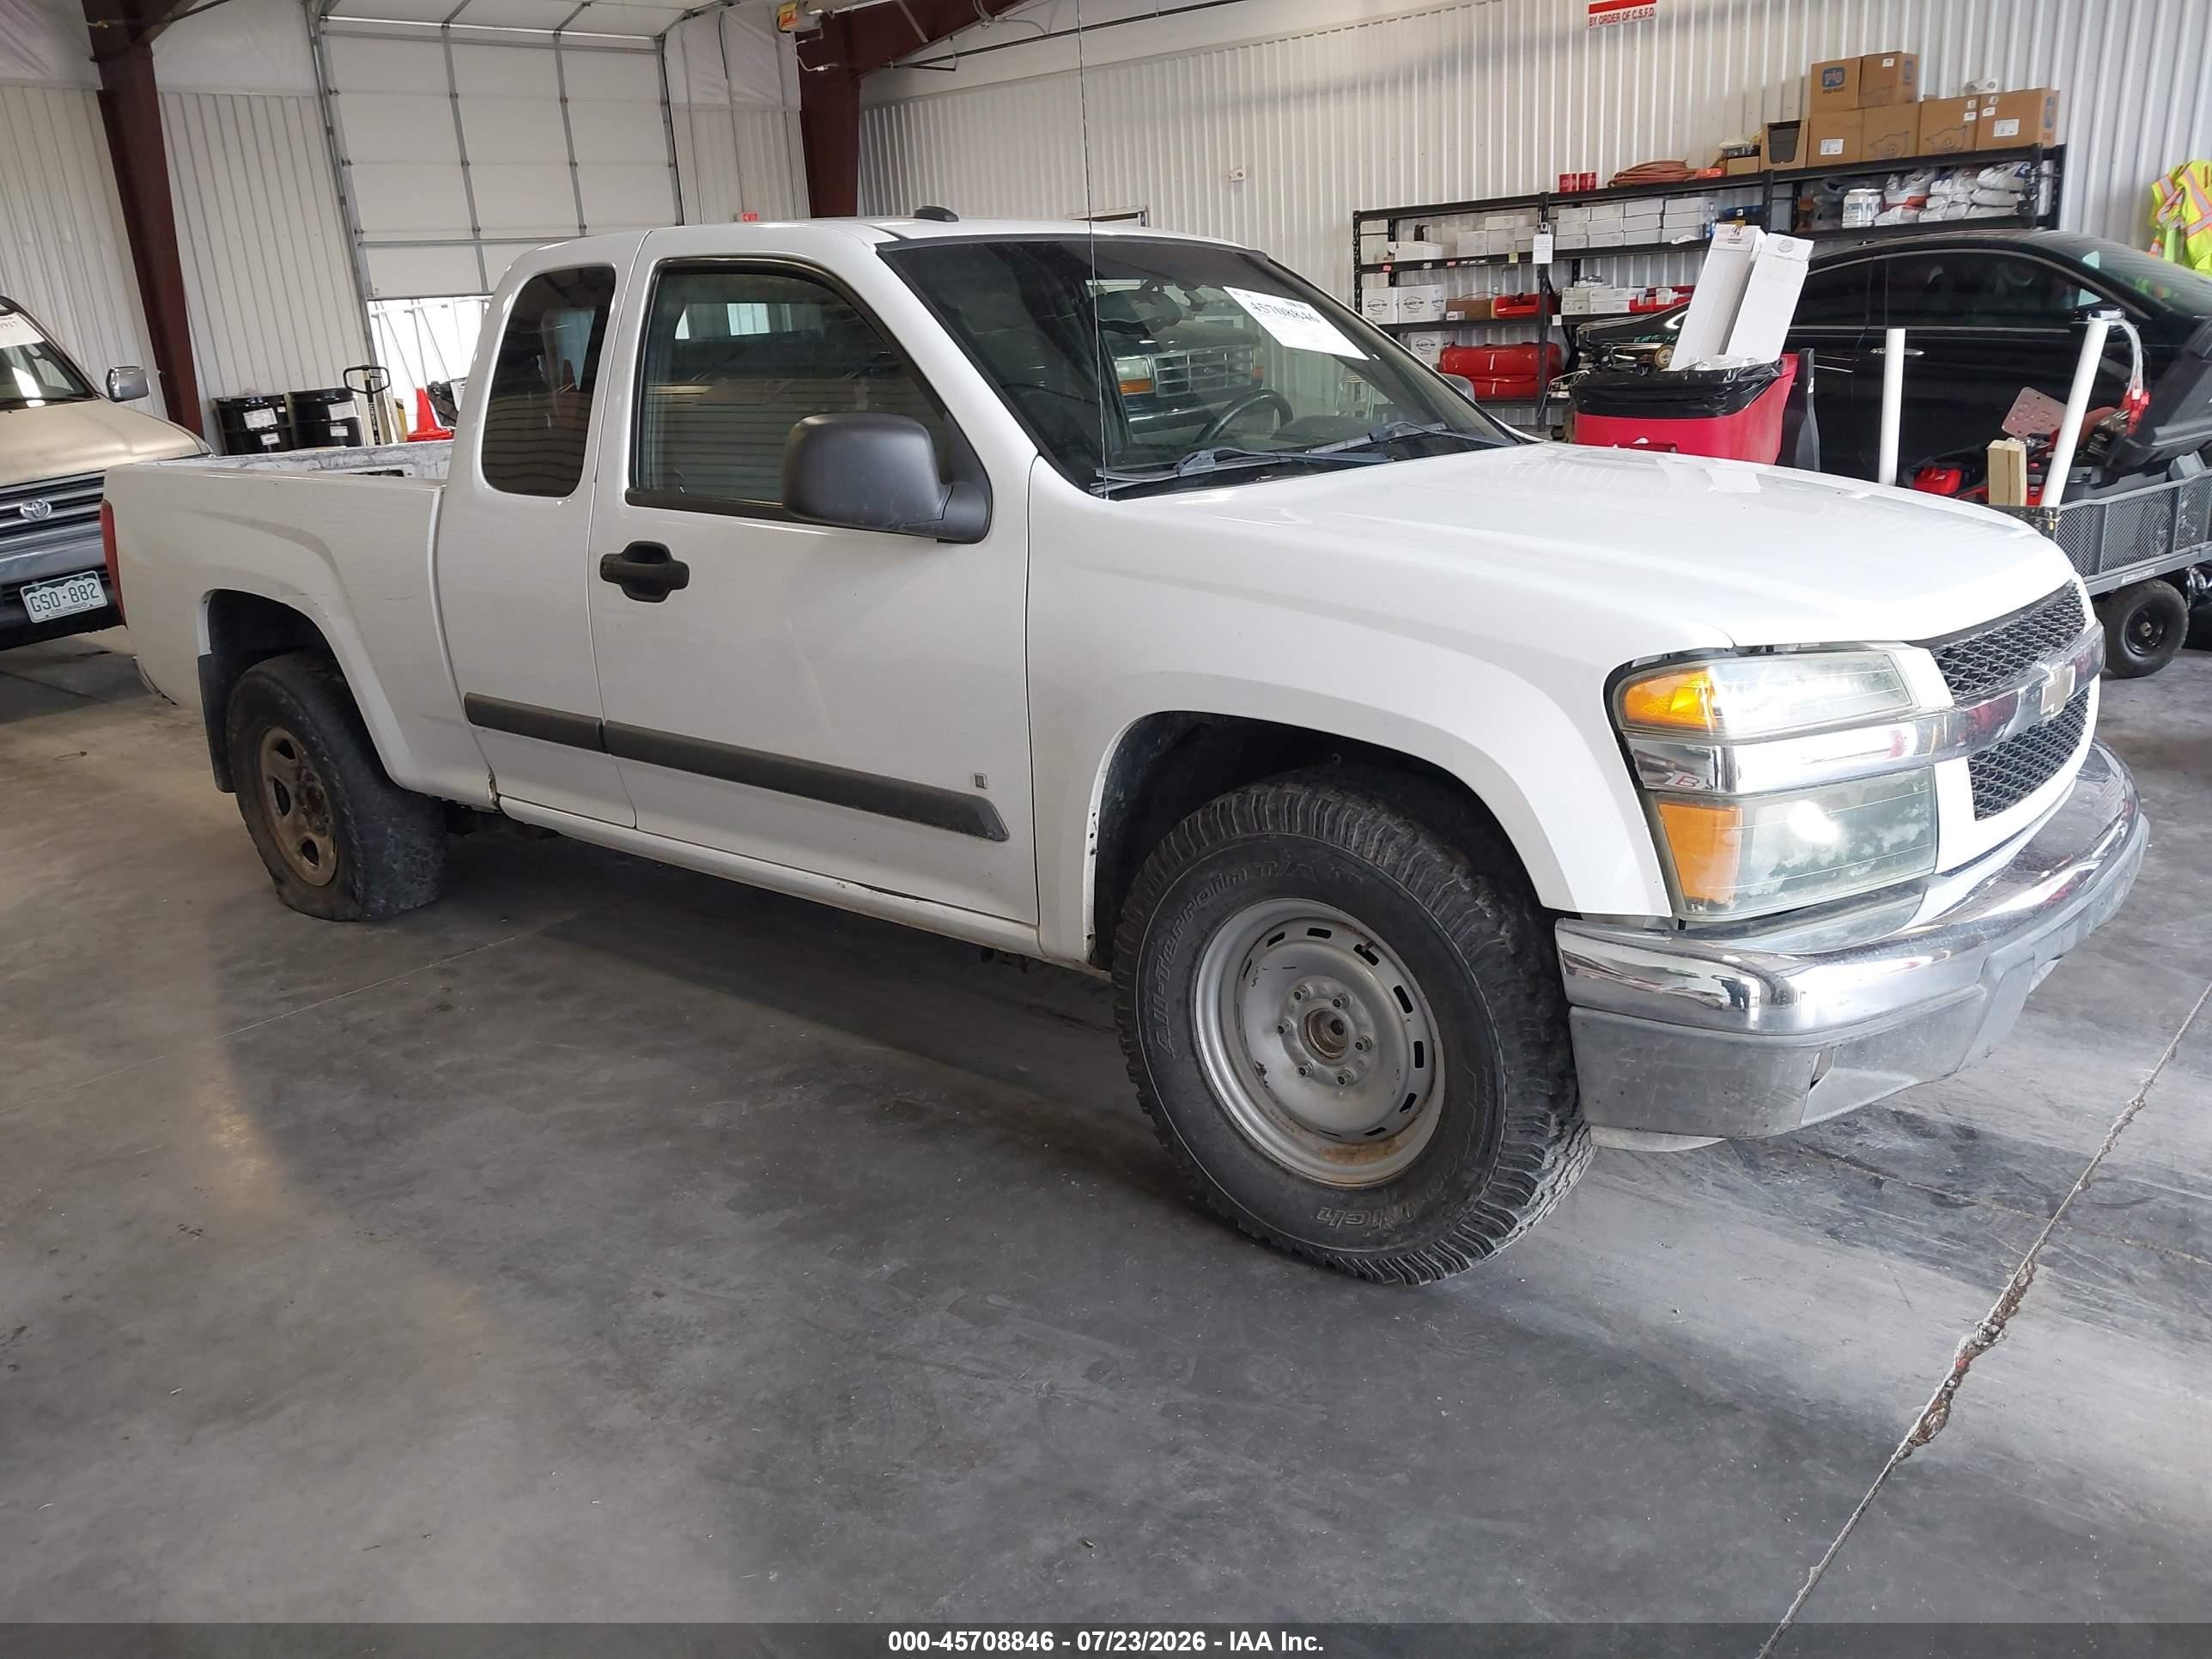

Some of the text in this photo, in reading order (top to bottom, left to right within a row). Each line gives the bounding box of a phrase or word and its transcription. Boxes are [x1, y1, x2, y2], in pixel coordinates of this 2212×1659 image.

[1589, 15, 1597, 27] BY
[1599, 12, 1620, 25] ORDER
[1622, 10, 1631, 21] OF
